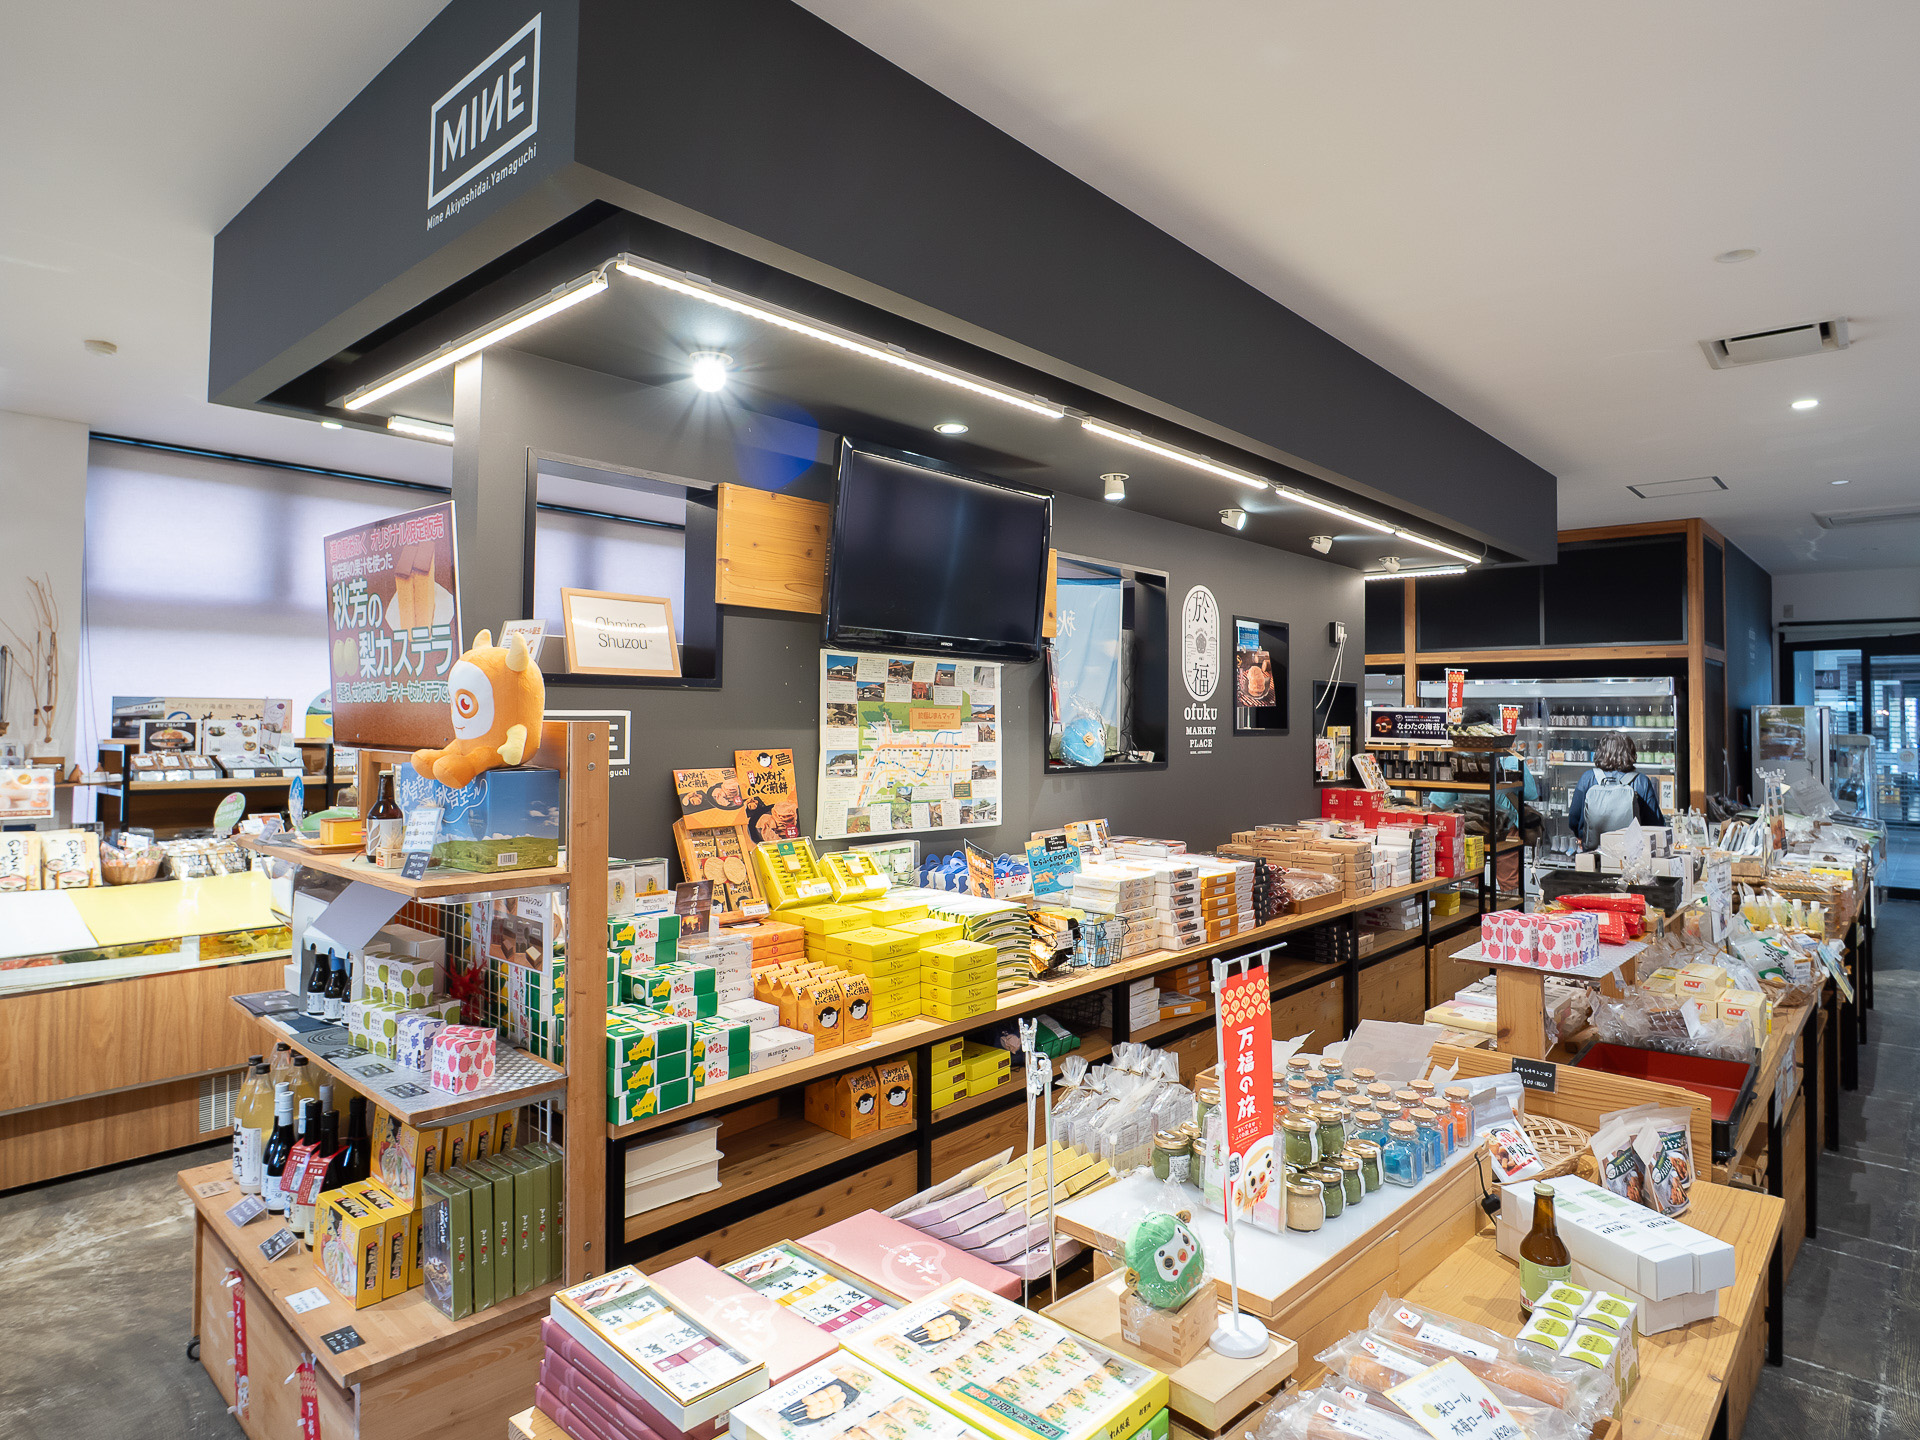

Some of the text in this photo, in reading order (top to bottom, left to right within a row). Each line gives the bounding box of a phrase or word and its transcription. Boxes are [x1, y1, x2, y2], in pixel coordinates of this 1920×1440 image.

[441, 55, 526, 172] MINE
[426, 212, 444, 231] Mine
[370, 513, 444, 551] オリジナル限定販売
[332, 578, 383, 631] 秋芳の
[358, 623, 452, 679] 梨カステラ
[598, 633, 648, 649] Shuzou
[1192, 591, 1210, 694] 於 福
[1184, 703, 1218, 721] ofuku
[1186, 727, 1216, 735] MARKET
[1190, 739, 1213, 748] PLACE
[459, 785, 481, 807] エール
[1434, 1392, 1472, 1417] 梨ロール
[1450, 1409, 1493, 1437] 木苺ロール
